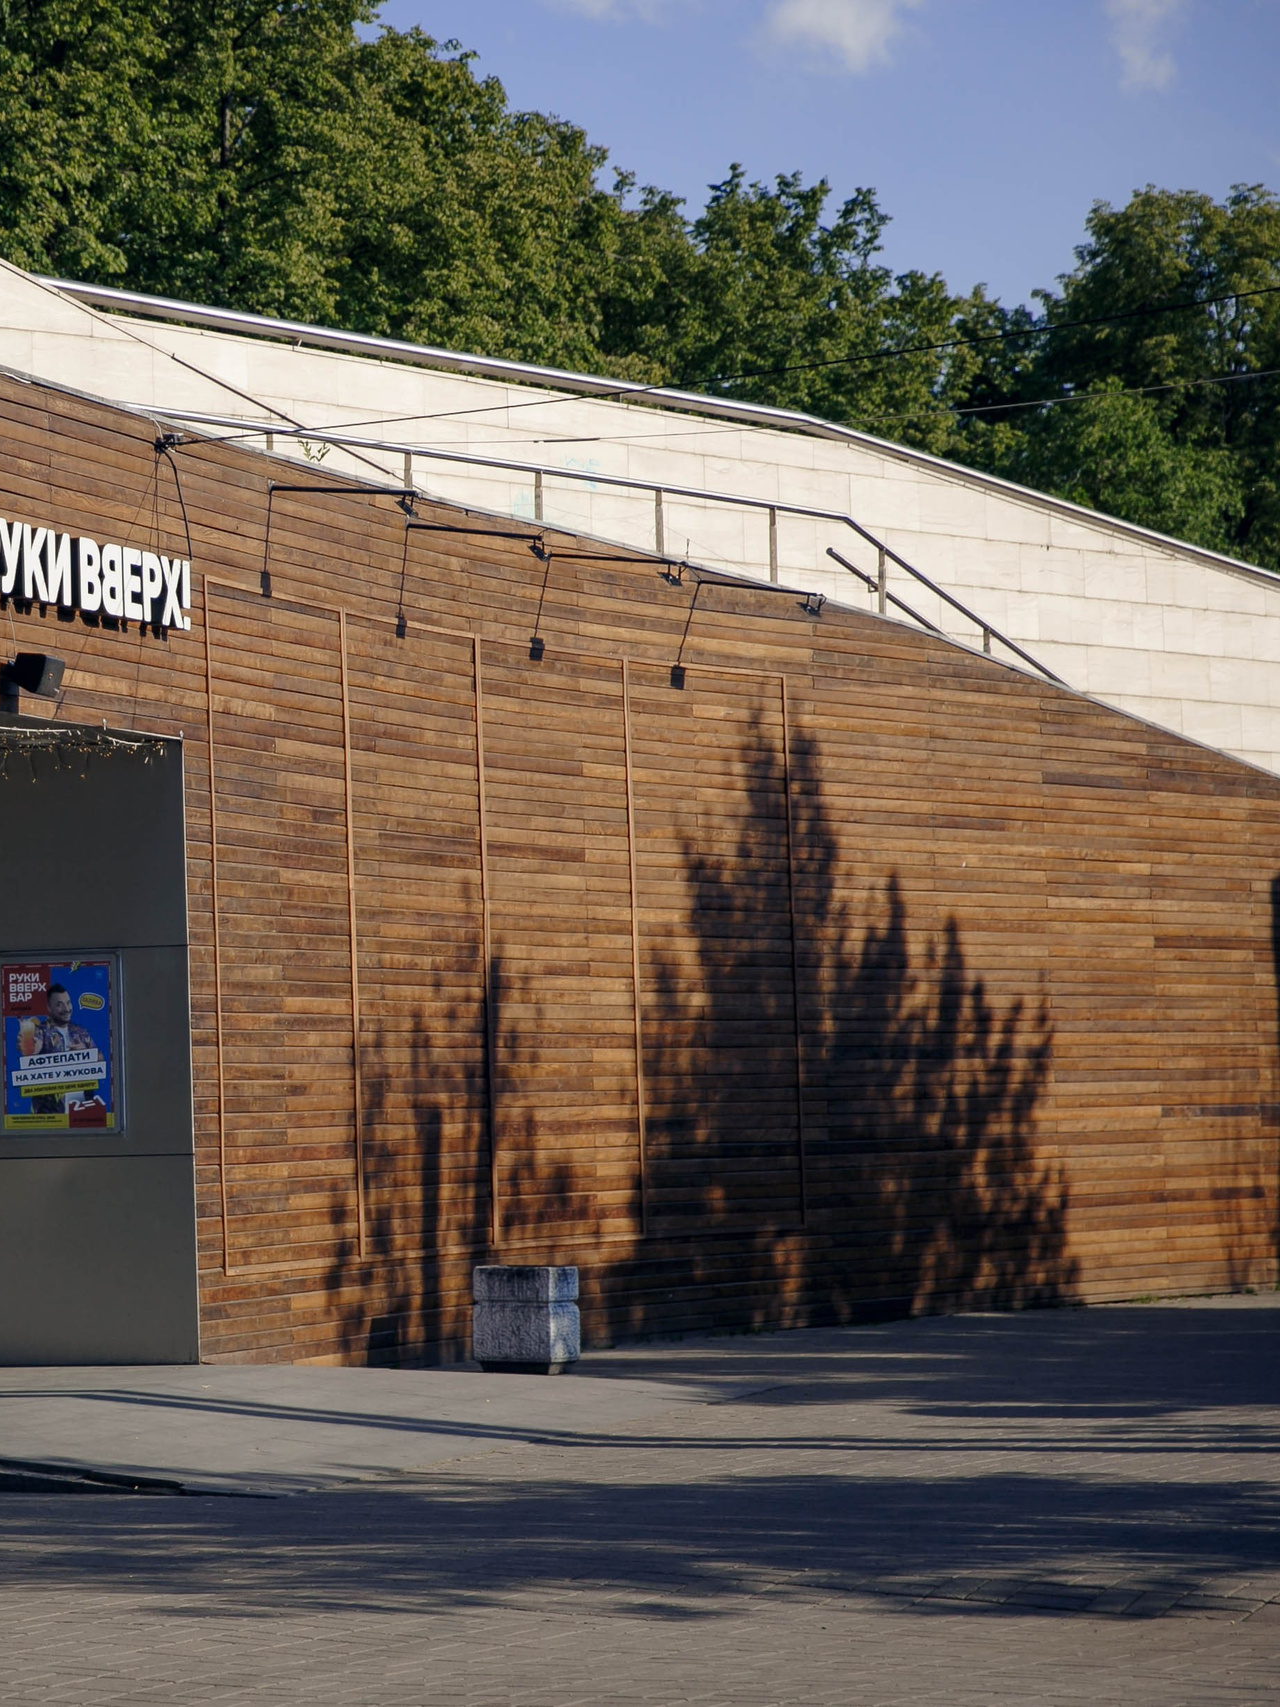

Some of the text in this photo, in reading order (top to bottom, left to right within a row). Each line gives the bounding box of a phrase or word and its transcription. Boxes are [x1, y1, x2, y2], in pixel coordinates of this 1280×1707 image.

[78, 536, 192, 632] ВВЕРХ!
[9, 972, 40, 983] РУКИ
[9, 982, 47, 992] ВВЕРХ
[9, 992, 33, 1003] БАР
[28, 1051, 90, 1067] АФТЕПАТИ
[15, 1073, 29, 1082] НА
[30, 1071, 54, 1081] ХАТЕ
[63, 1066, 104, 1077] ЖУКОВА
